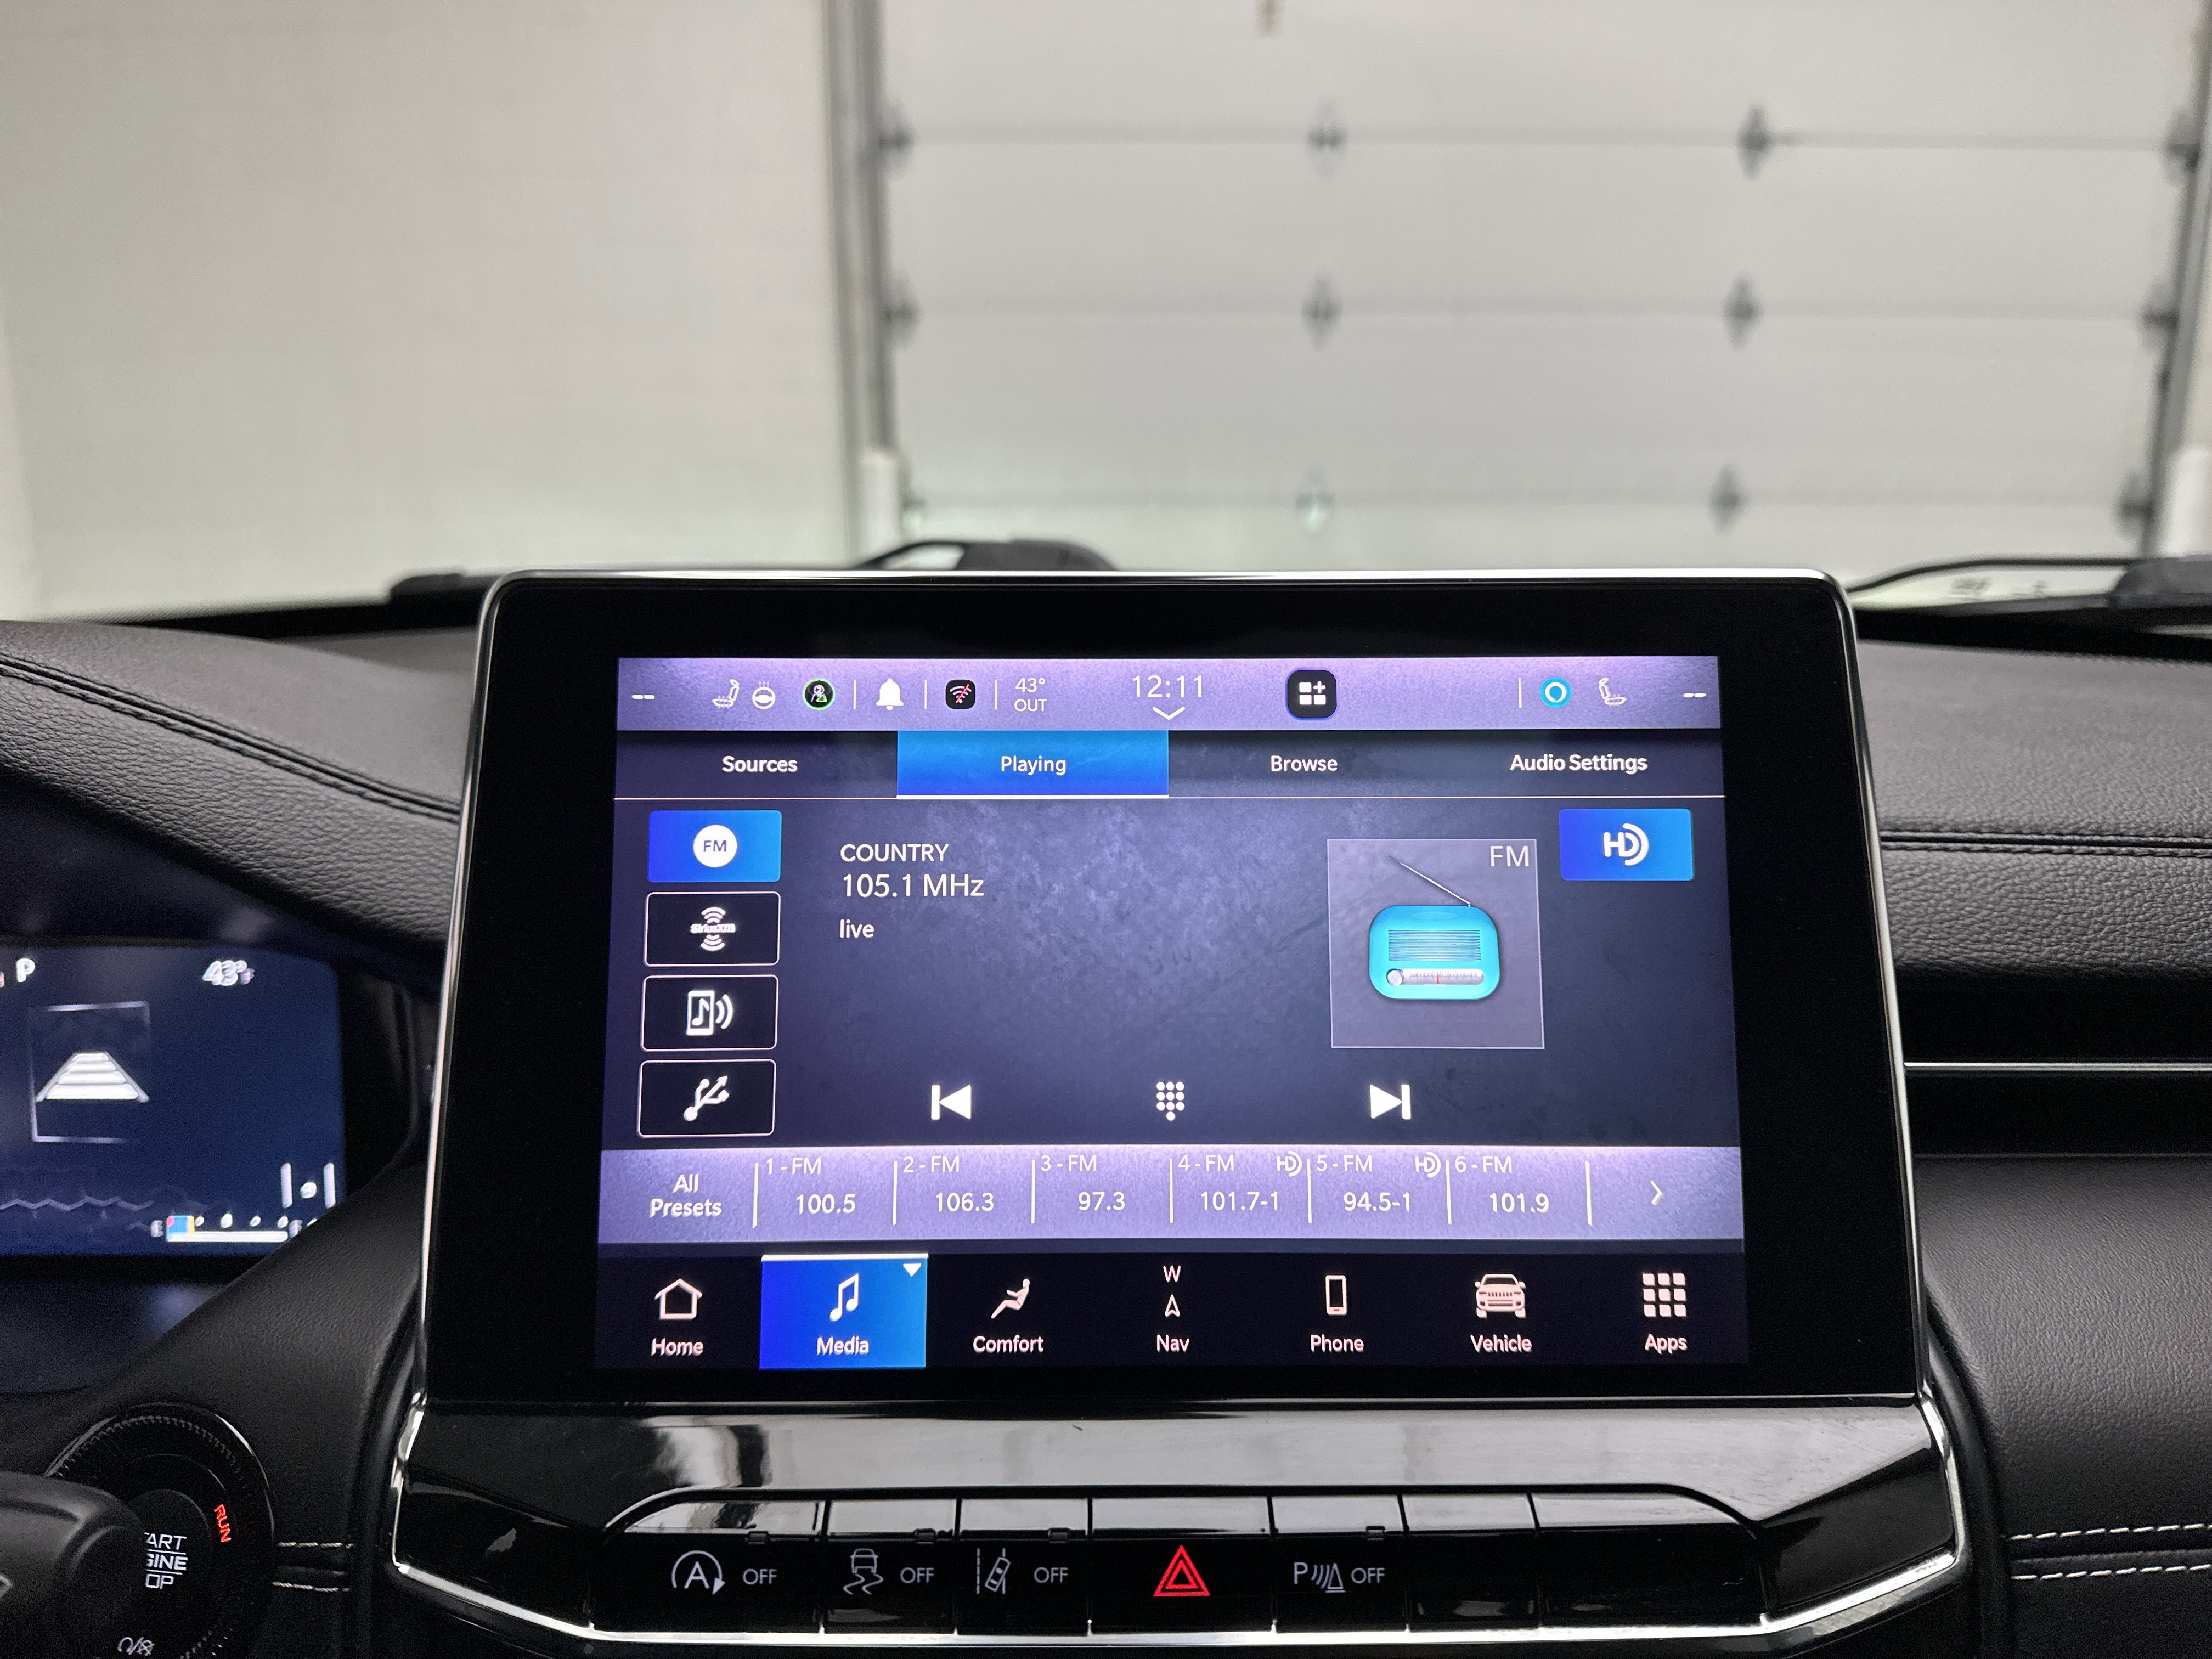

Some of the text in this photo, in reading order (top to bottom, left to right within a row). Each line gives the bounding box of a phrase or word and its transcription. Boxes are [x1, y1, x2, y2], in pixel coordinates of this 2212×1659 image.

[1015, 678, 1046, 693] 43°
[1132, 674, 1202, 698] 12:11
[1014, 698, 1048, 712] OUT
[722, 755, 798, 772] Sources
[1001, 755, 1066, 776] Playing
[1271, 755, 1338, 771] Browse
[1510, 753, 1648, 775] Audio Settings
[703, 839, 727, 854] FM
[840, 843, 949, 862] COUNTRY
[1490, 845, 1529, 867] FM
[843, 873, 984, 898] 105.1 MHz
[840, 919, 874, 938] live
[16, 958, 36, 983] P
[792, 1157, 821, 1175] FM
[931, 1155, 960, 1173] FM
[1069, 1154, 1097, 1172] FM
[1206, 1154, 1234, 1171] FM
[1344, 1155, 1373, 1172] FM
[1483, 1155, 1512, 1173] FM
[673, 1173, 699, 1193] All
[650, 1198, 721, 1217] Presets
[797, 1193, 856, 1214] 100.5
[935, 1192, 994, 1212] 106.3
[1078, 1191, 1125, 1211] 97.3
[1201, 1191, 1278, 1211] 101.7-1
[1344, 1192, 1410, 1212] 94.5-1
[1489, 1193, 1549, 1213] 101.9
[1163, 1266, 1181, 1282] W
[651, 1338, 704, 1356] Home
[817, 1336, 869, 1355] Media
[973, 1334, 1044, 1353] Comfort
[1156, 1334, 1190, 1352] Nav
[1311, 1334, 1364, 1352] Phone
[1470, 1334, 1532, 1352] Vehicle
[1644, 1334, 1688, 1355] Apps
[214, 1504, 232, 1543] RUN
[144, 1532, 187, 1550] ART
[146, 1553, 188, 1571] GINE
[145, 1573, 174, 1589] OP
[684, 1561, 776, 1589] A OFF
[900, 1567, 934, 1583] OFF
[1034, 1567, 1068, 1583] OFF
[1294, 1562, 1385, 1584] P OFF
